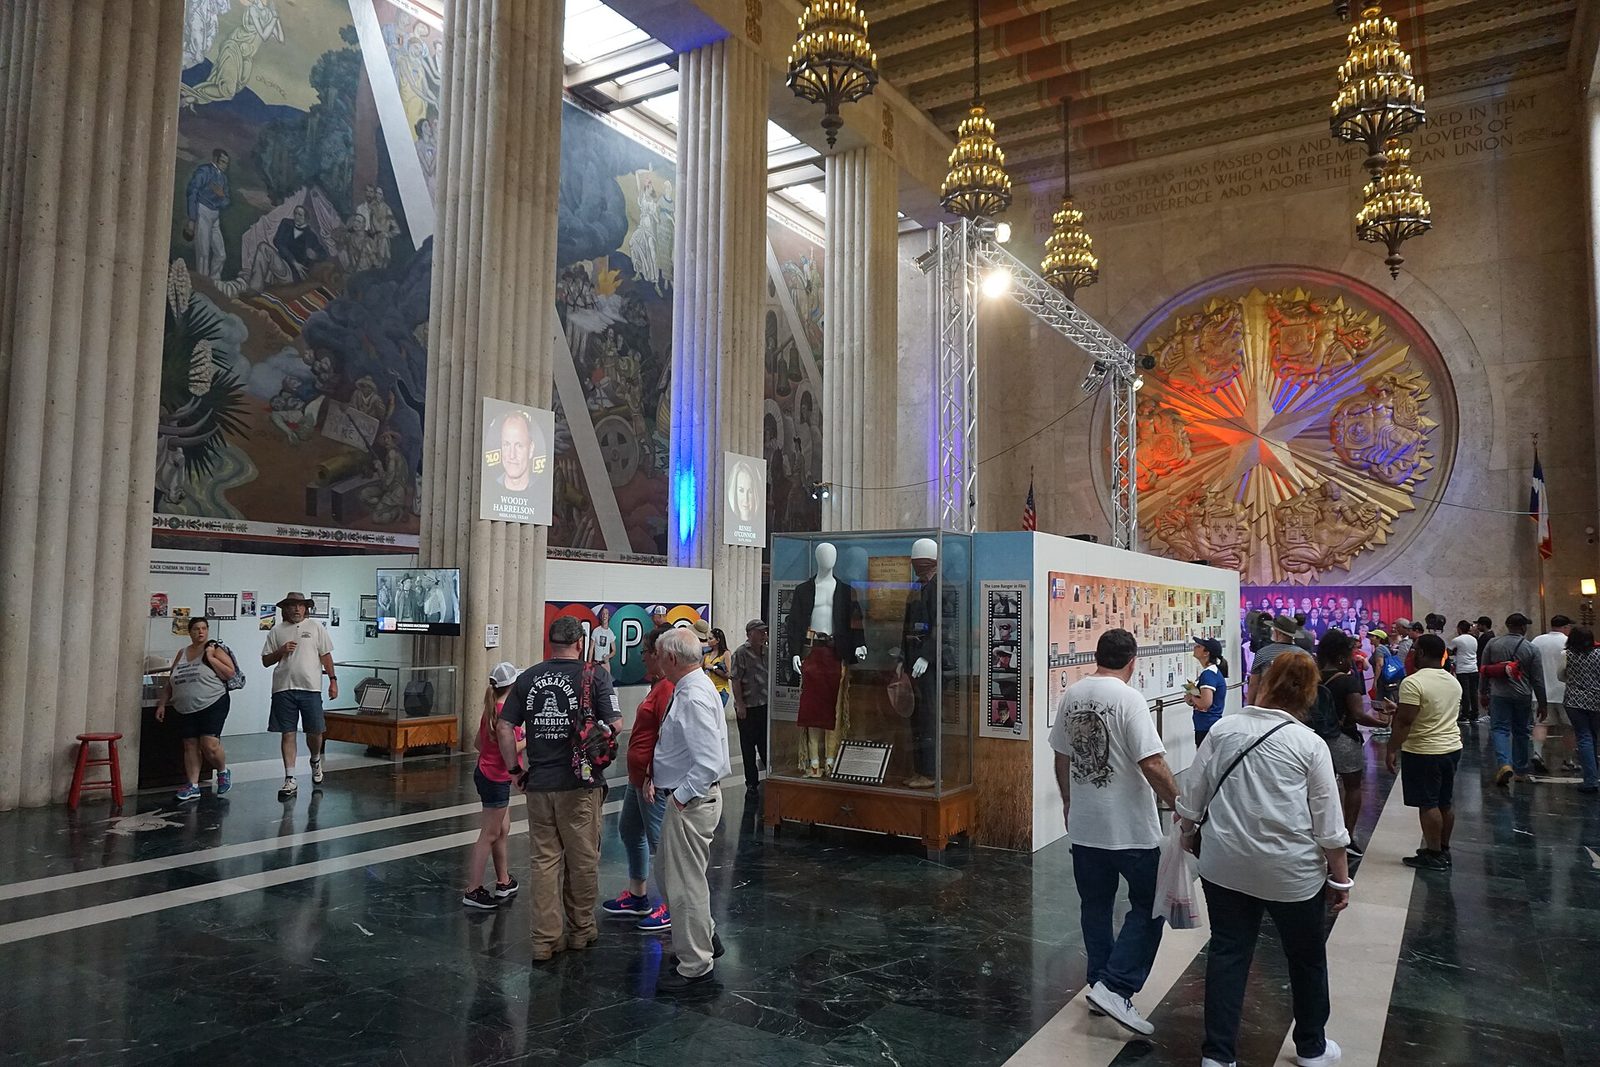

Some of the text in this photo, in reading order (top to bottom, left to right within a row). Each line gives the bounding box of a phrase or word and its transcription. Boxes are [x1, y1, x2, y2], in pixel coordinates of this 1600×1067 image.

[1086, 182, 1111, 195] STAR
[1114, 178, 1133, 192] OF
[1139, 170, 1175, 185] TEXAS
[1184, 162, 1209, 177] HAS
[1213, 151, 1263, 171] PASSED
[1267, 145, 1292, 161] ON
[1297, 138, 1332, 154] AND
[1422, 111, 1463, 130] IXED
[1469, 105, 1486, 120] IN
[1492, 95, 1537, 114] THAT
[1100, 179, 1210, 208] CONSTELLATION
[1215, 167, 1263, 185] WHICH
[1269, 162, 1295, 176] ALL
[1419, 124, 1483, 147] LOVERS
[1488, 116, 1514, 133] OF
[1099, 206, 1131, 221] MUST
[1136, 190, 1213, 216] REVERENCE
[1220, 184, 1252, 199] AND
[1260, 172, 1314, 193] ADORE
[1320, 165, 1351, 181] THE
[1455, 134, 1514, 156] UNION
[500, 495, 529, 506] WOODY
[493, 503, 535, 515] HARRELSON
[535, 677, 565, 690] TREAD
[562, 684, 575, 697] ON
[568, 696, 579, 710] ME
[533, 718, 570, 726] AMERICA
